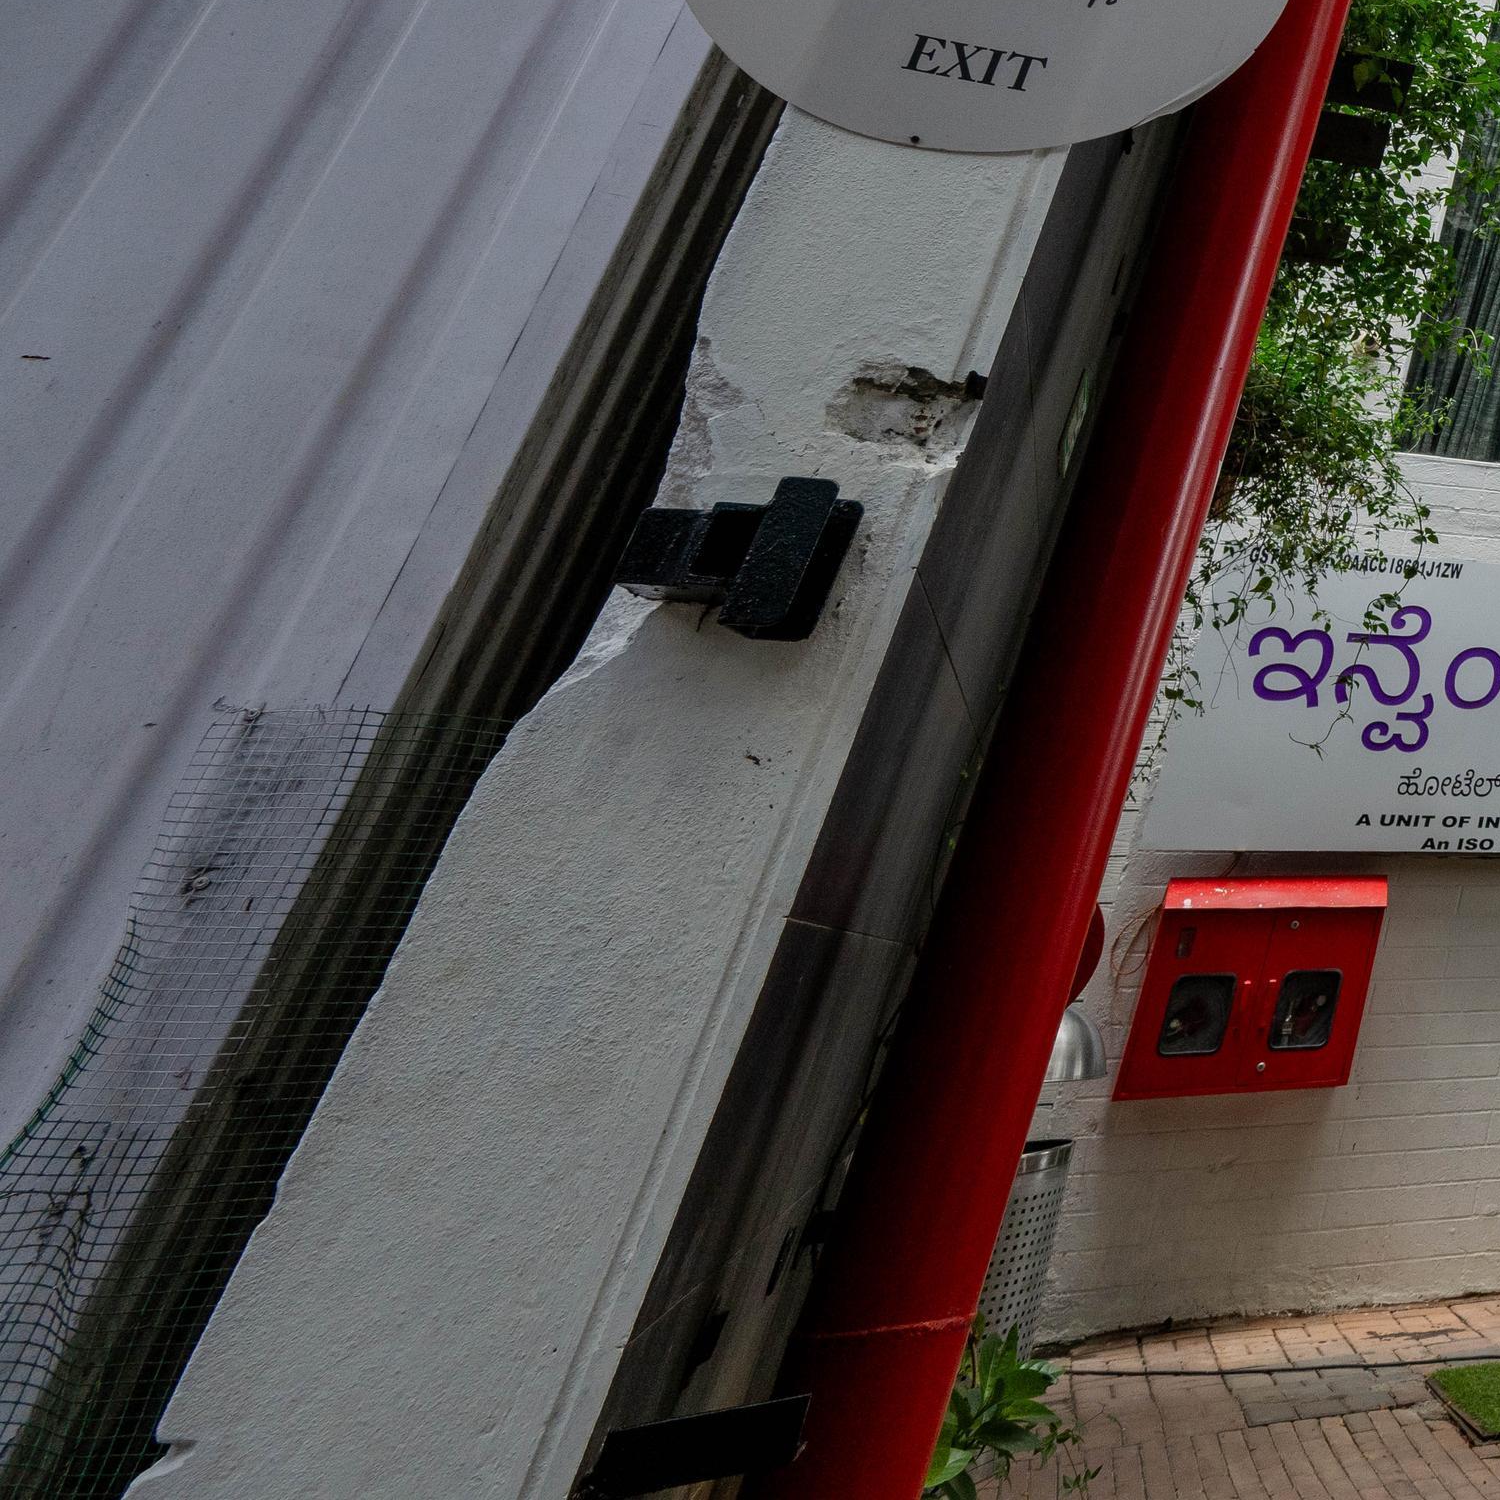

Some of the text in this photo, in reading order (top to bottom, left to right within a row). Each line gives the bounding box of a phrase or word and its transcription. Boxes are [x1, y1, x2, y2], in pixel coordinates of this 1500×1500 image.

[901, 34, 1047, 91] EXIT
[1356, 814, 1371, 826] A
[1380, 814, 1435, 828] UNIT
[1442, 815, 1471, 828] OF
[1421, 837, 1449, 850] An
[1456, 838, 1495, 851] ISO
